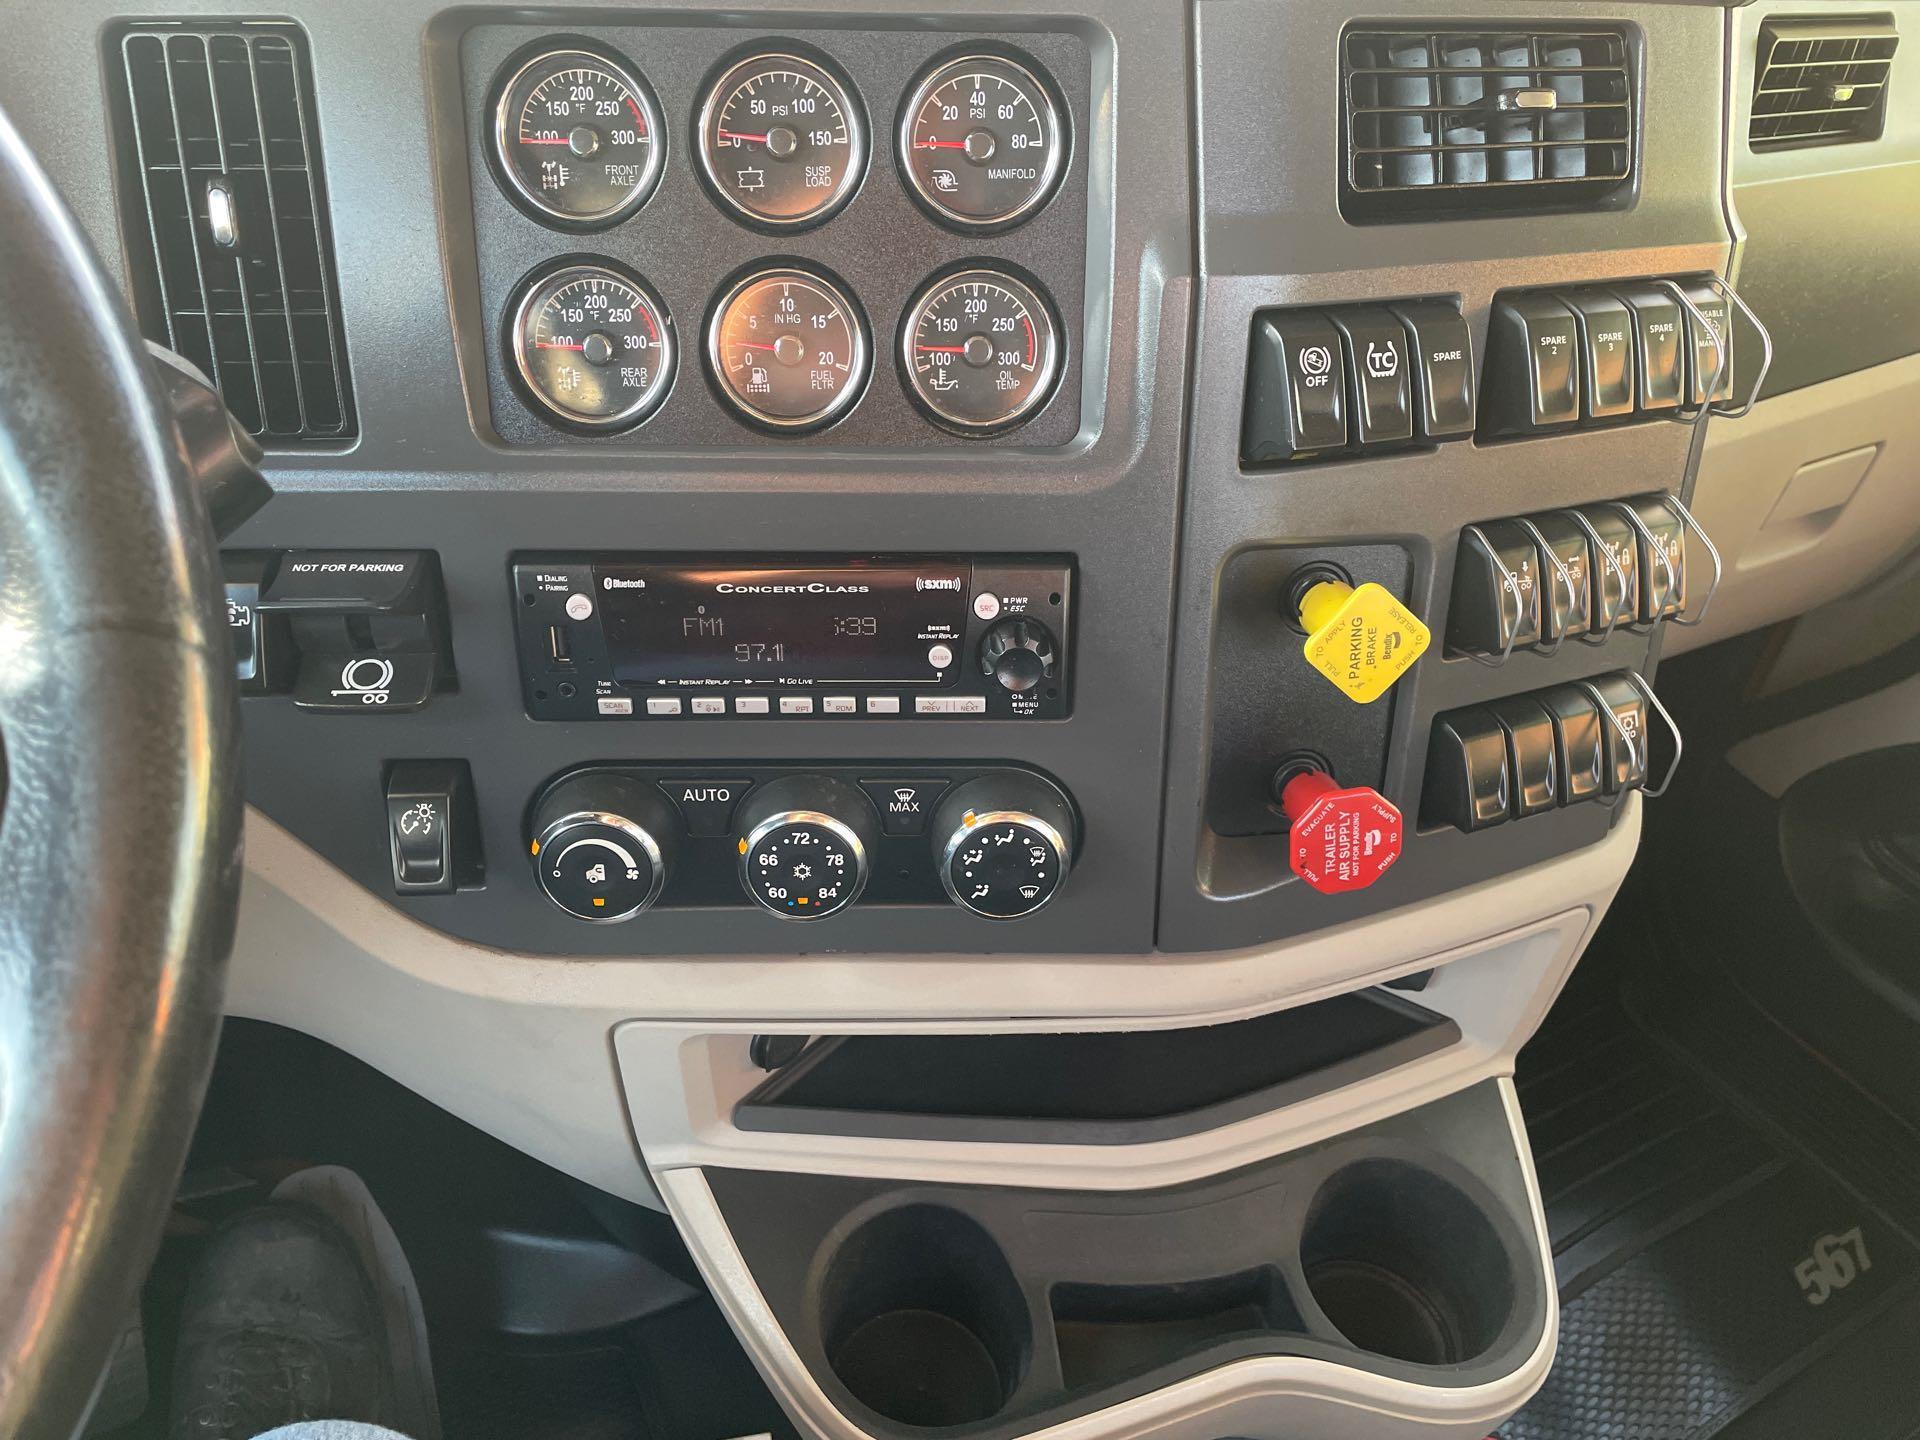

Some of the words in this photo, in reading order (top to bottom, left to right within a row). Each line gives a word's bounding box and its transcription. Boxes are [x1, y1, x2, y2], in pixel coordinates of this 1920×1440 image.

[570, 86, 594, 101] 200
[969, 91, 986, 106] 40
[546, 102, 570, 116] 150
[595, 101, 620, 116] 250
[750, 99, 766, 115] 50
[772, 105, 789, 116] PSI
[791, 98, 815, 114] 100
[942, 105, 958, 120] 20
[997, 104, 1014, 120] 60
[969, 108, 986, 119] PSI
[535, 130, 559, 144] 100
[611, 130, 635, 145] 300
[733, 134, 741, 148] 0
[808, 131, 832, 146] 150
[929, 135, 937, 150] 0
[1011, 134, 1027, 149] 80
[605, 164, 639, 175] FRONT
[805, 166, 831, 177] SUSP
[988, 168, 1036, 179] MANIFOLD
[610, 176, 635, 186] AXLE
[805, 176, 832, 187] LOAD
[584, 294, 608, 309] 200
[779, 298, 795, 312] 10
[964, 299, 988, 313] 200
[560, 309, 584, 323] 150
[608, 308, 632, 323] 250
[749, 315, 757, 329] 5
[774, 313, 785, 324] IN
[786, 313, 801, 324] HG
[811, 314, 826, 329] 15
[935, 318, 958, 332] 150
[992, 317, 1015, 332] 250
[1649, 323, 1674, 334] SPARE
[551, 335, 574, 348] 100
[623, 335, 647, 349] 300
[1540, 335, 1567, 347] SPARE
[1598, 331, 1623, 343] SPARE
[1659, 333, 1665, 342] 4
[1551, 346, 1558, 355] 2
[1608, 343, 1614, 352] 3
[745, 352, 753, 366] 0
[818, 351, 834, 365] 20
[929, 352, 950, 366] 100
[998, 351, 1020, 366] 300
[1371, 351, 1394, 369] TC
[1433, 350, 1462, 362] SPARE
[620, 367, 648, 377] REAR
[810, 370, 835, 380] FUEL
[999, 370, 1013, 380] OIL
[622, 377, 647, 387] AXLE
[811, 380, 834, 390] FLTR
[996, 380, 1021, 390] TEMP
[1305, 375, 1329, 388] OFF
[292, 564, 319, 572] NOT
[320, 564, 346, 572] FOR
[348, 564, 404, 572] PARKING
[613, 578, 645, 589] Bluetooth
[683, 617, 725, 636] FM1
[1388, 607, 1417, 634] RELEASE
[1325, 620, 1346, 644] APPLY
[1366, 627, 1377, 666] BRAKE
[1415, 634, 1423, 646] TO
[1316, 646, 1324, 658] TO
[1348, 617, 1363, 679] PARKING
[1395, 650, 1417, 671] PUSH
[1324, 661, 1341, 677] PULL
[683, 788, 730, 802] AUTO
[889, 802, 920, 812] MAX
[1371, 803, 1397, 824] SUPPLY
[1302, 802, 1335, 837] EVACUATE
[1339, 811, 1351, 859] SUPPLY
[1352, 812, 1360, 845] PARKING
[791, 832, 810, 845] 72
[1390, 832, 1397, 843] TO
[1299, 847, 1306, 857] TO
[1325, 823, 1336, 875] TRAILER
[1352, 846, 1360, 861] FOR
[759, 854, 778, 866] 66
[826, 854, 844, 866] 78
[1377, 852, 1396, 871] PUSH
[1304, 868, 1319, 883] PULL
[1339, 861, 1350, 880] AIR
[1352, 863, 1360, 876] NOT
[768, 887, 787, 899] 60
[818, 887, 837, 899] 84
[1794, 1225, 1872, 1305] 567
